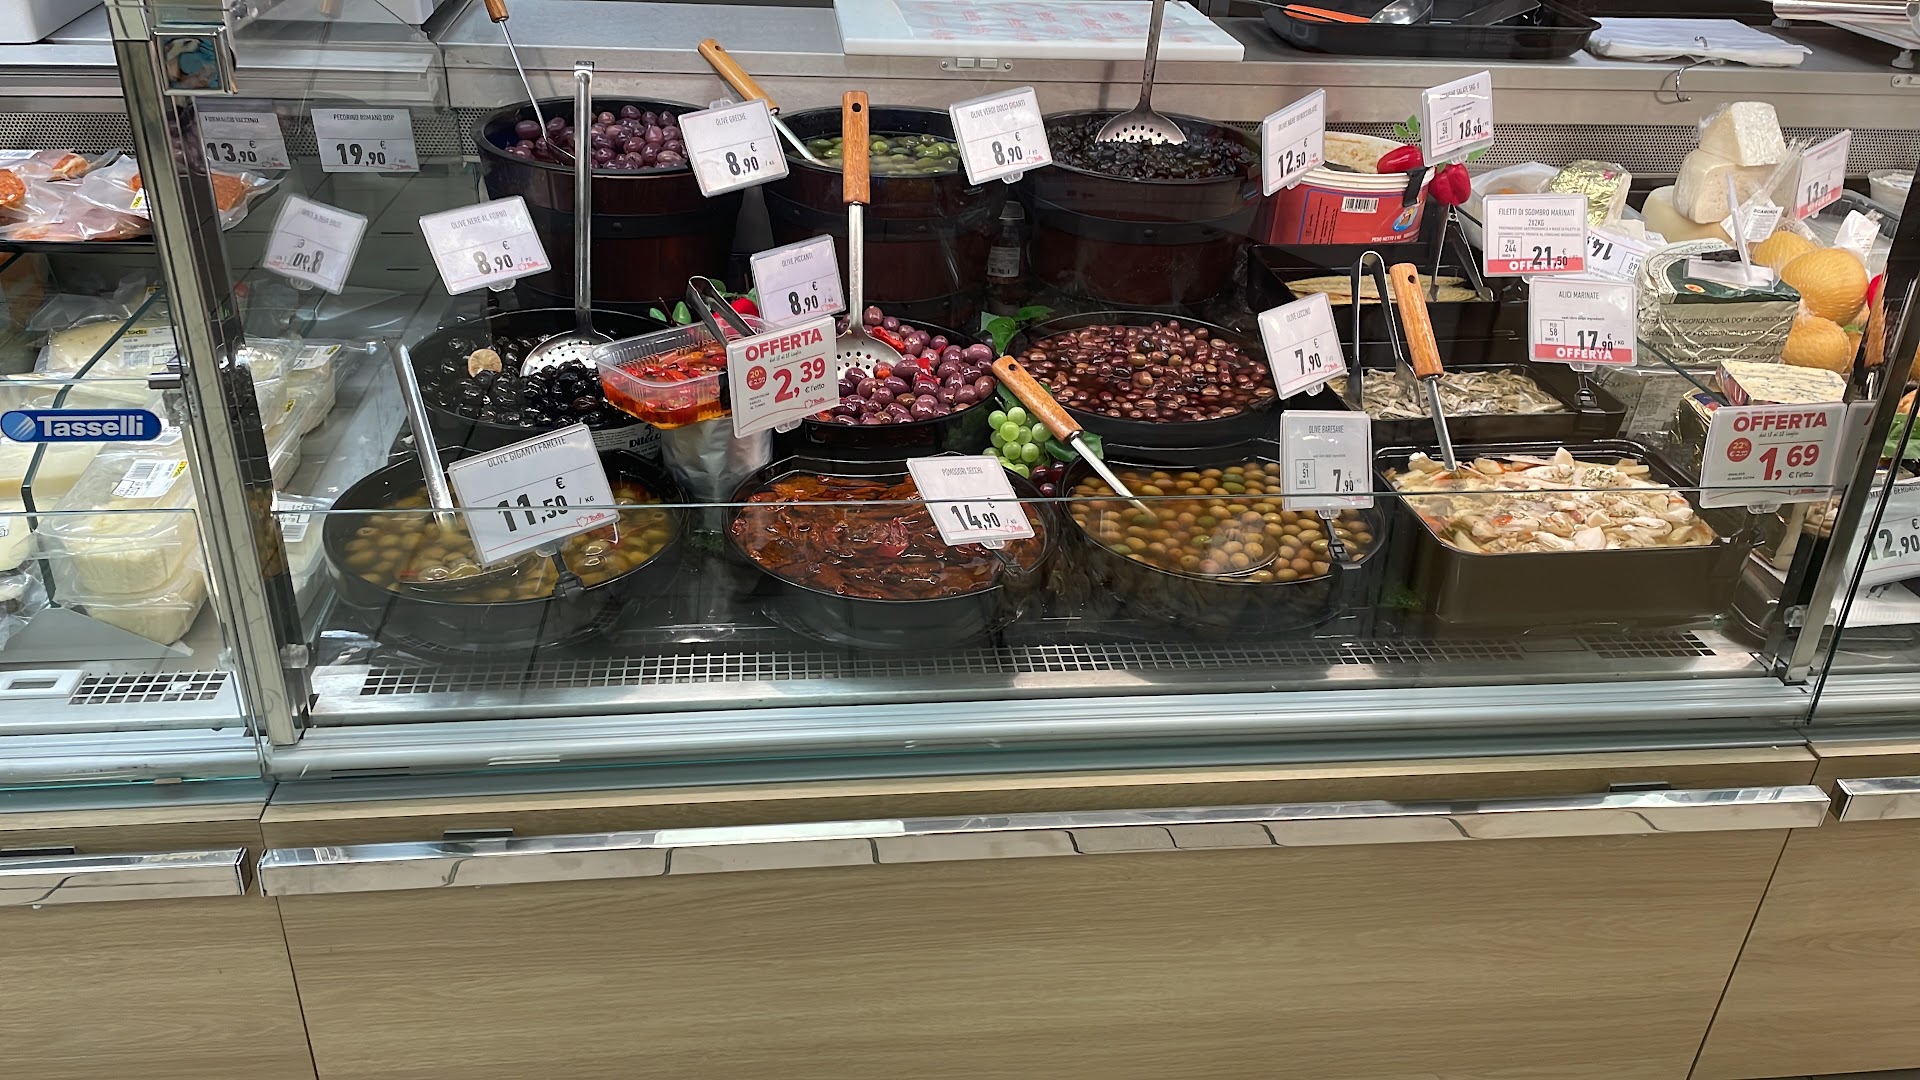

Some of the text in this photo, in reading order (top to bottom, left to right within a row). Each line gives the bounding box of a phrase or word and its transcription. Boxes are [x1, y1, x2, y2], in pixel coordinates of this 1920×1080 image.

[970, 99, 1026, 119] OLIVE VERDI DOLCI GIGANTI
[333, 113, 359, 121] PECORINO
[715, 112, 747, 126] OLIVE GRECHE
[1015, 132, 1021, 141] €
[1304, 138, 1308, 147] €
[249, 141, 257, 149] €
[380, 140, 386, 150] €
[750, 142, 757, 152] €
[207, 142, 257, 164] 13,90
[336, 143, 386, 166] 19,90
[992, 141, 1023, 165] 8,90
[725, 151, 759, 176] 8,90
[1278, 150, 1306, 178] 12,50
[1498, 208, 1518, 216] FILETTI
[1518, 208, 1524, 216] DI
[1551, 209, 1575, 217] MARINATI
[451, 210, 507, 230] OLIVE NERE AL FORNO
[1528, 219, 1545, 227] 2X2KG
[502, 240, 510, 250] €
[1505, 244, 1516, 252] 244
[473, 251, 514, 275] 8,90
[782, 252, 814, 268] OLIVE PICCANTI
[1533, 246, 1568, 267] 21,50
[1509, 261, 1565, 271] OFFERTA
[812, 281, 818, 291] €
[1559, 291, 1572, 299] ALICI
[788, 291, 819, 315] 8,90
[1286, 307, 1311, 322] OLIVE LECCINO
[1549, 328, 1558, 336] 58
[745, 328, 823, 362] OFFERTA
[1313, 338, 1319, 348] €
[1577, 330, 1613, 352] 17,90
[1556, 347, 1613, 360] OFFERTA
[1294, 348, 1322, 375] 7,90
[773, 357, 825, 403] 2,39
[37, 415, 144, 437] Tasselli
[1733, 412, 1828, 432] OFFERTA
[1309, 425, 1344, 434] OLIVE BARESANE
[487, 436, 567, 468] OLIVE GIGANTI FARCITE
[1759, 444, 1820, 481] 1,69
[966, 467, 984, 475] SECCHI
[1302, 468, 1309, 478] 51
[1788, 471, 1794, 479] €
[555, 477, 566, 490] €
[1333, 469, 1354, 493] 7,90
[497, 493, 568, 532] 11,50
[585, 495, 595, 503] KG
[588, 512, 605, 523] Todis
[950, 504, 1001, 530] 14,90
[1911, 518, 1920, 530] €
